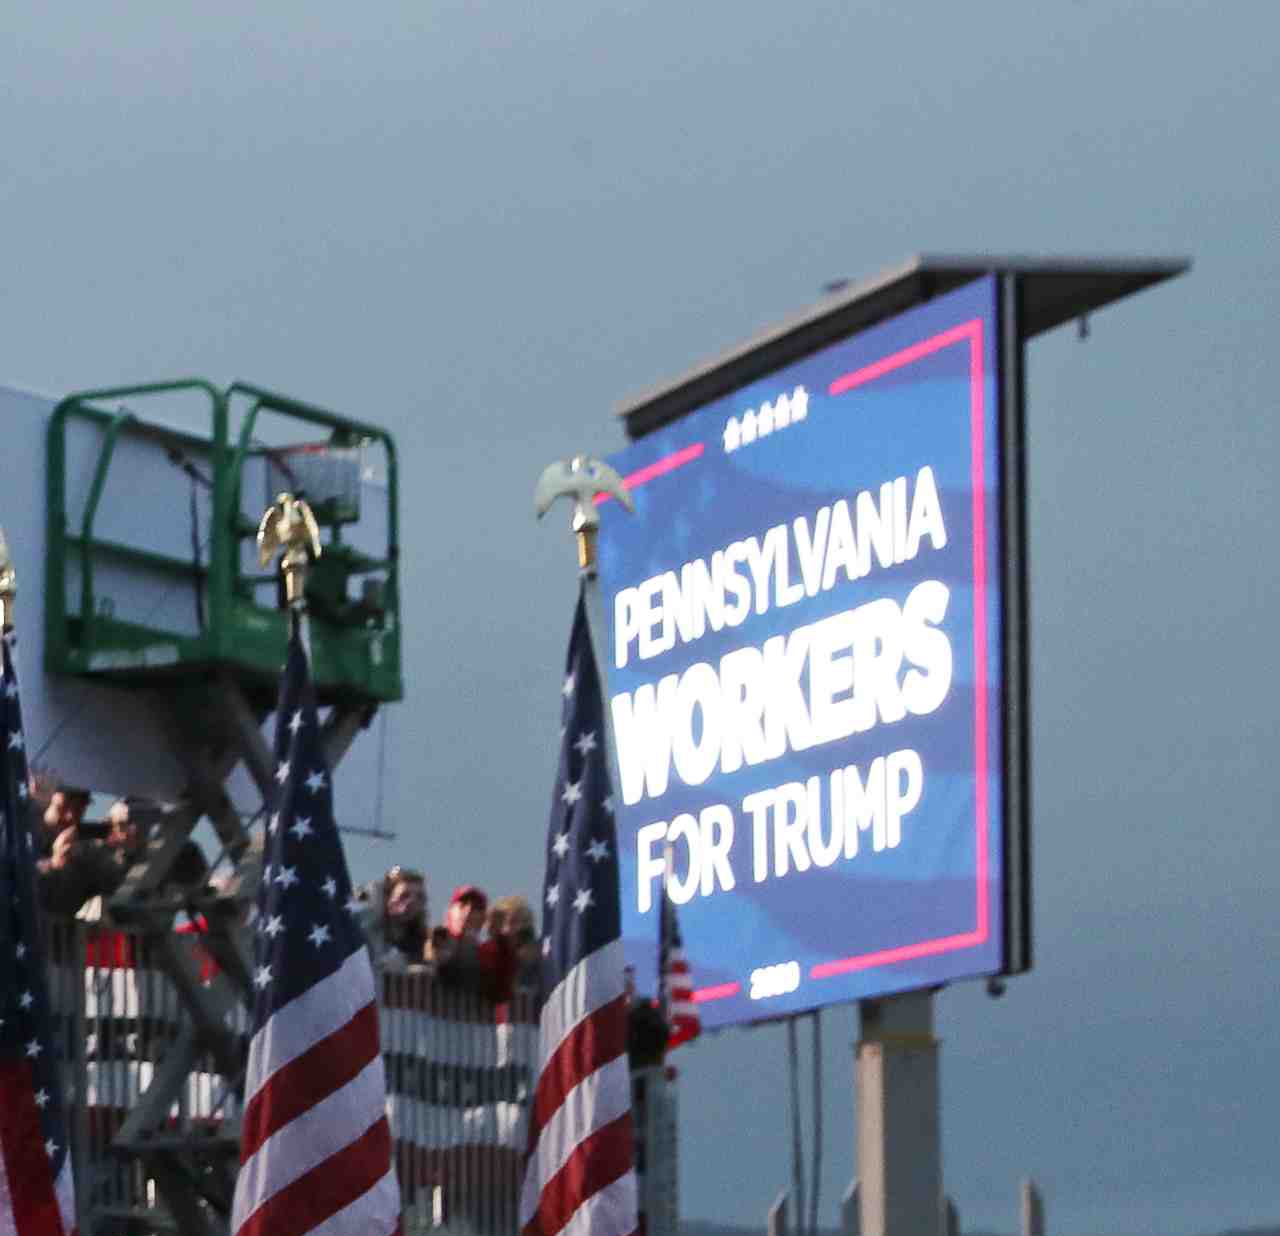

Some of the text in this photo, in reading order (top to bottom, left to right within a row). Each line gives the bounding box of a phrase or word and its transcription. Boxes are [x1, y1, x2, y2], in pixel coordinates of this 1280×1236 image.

[614, 464, 947, 669] PENNSYLVANIA
[610, 579, 953, 806] WORKERS
[637, 749, 923, 914] FOR TRUMP
